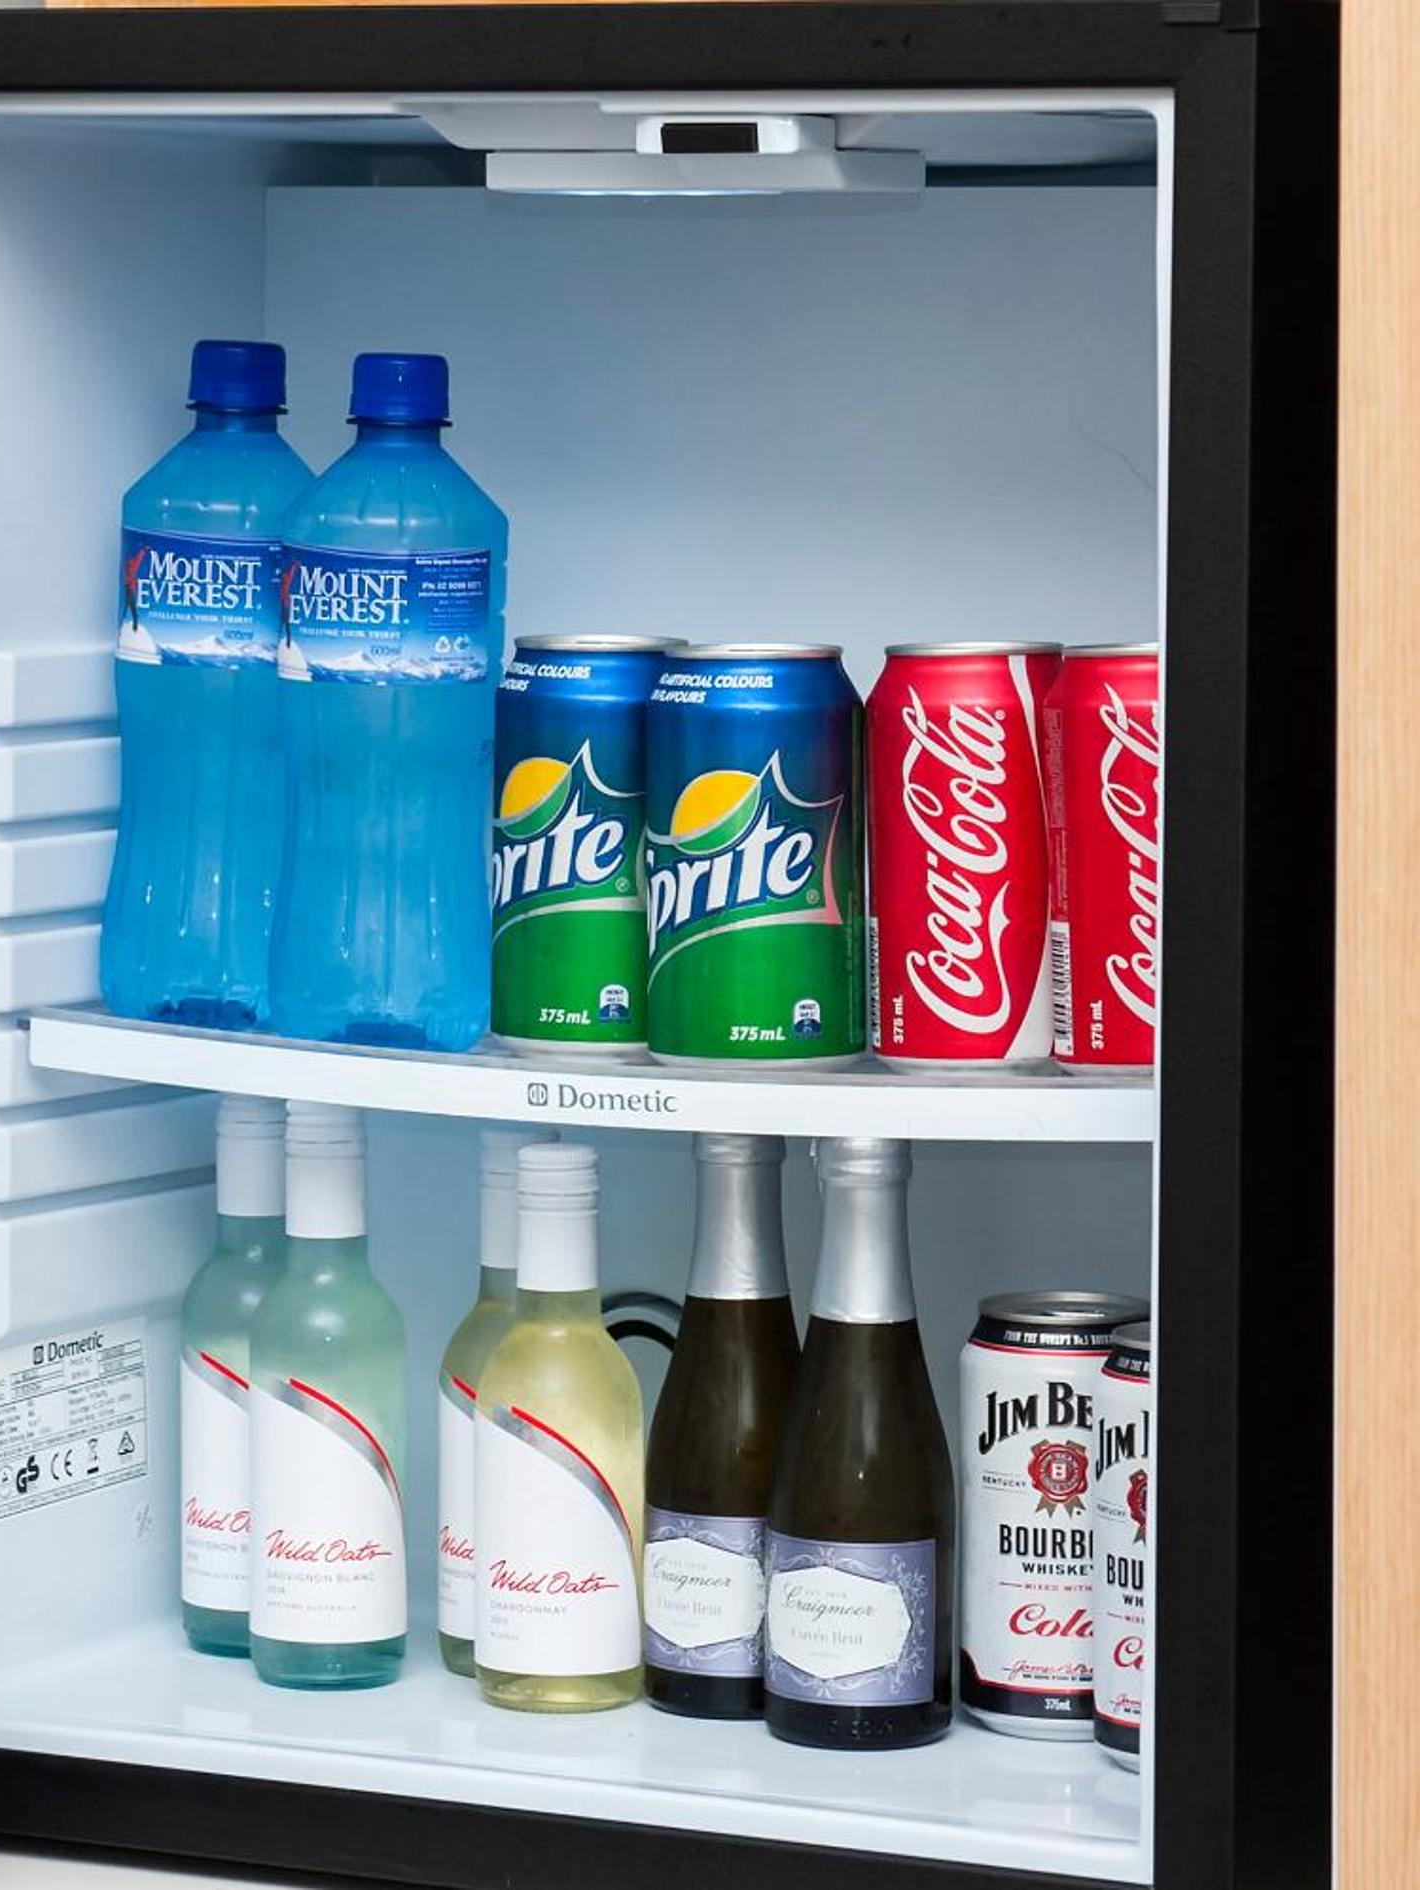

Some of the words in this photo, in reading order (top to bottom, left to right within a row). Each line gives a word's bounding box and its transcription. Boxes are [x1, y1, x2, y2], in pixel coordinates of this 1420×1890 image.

[148, 550, 262, 585] MOUNT
[300, 565, 408, 600] MOUNT
[537, 663, 591, 679] COLOURS
[714, 674, 773, 689] COLOURS
[557, 1083, 678, 1113] Dometic
[47, 1331, 104, 1362] Dometic
[978, 1391, 1039, 1455] JIM
[1046, 1381, 1094, 1432] BE
[1095, 1418, 1136, 1481] JIM
[265, 1529, 325, 1562] Wild
[324, 1539, 393, 1563] Oats
[998, 1523, 1094, 1560] BOURB
[489, 1559, 548, 1594] Wild
[547, 1571, 620, 1595] Oats
